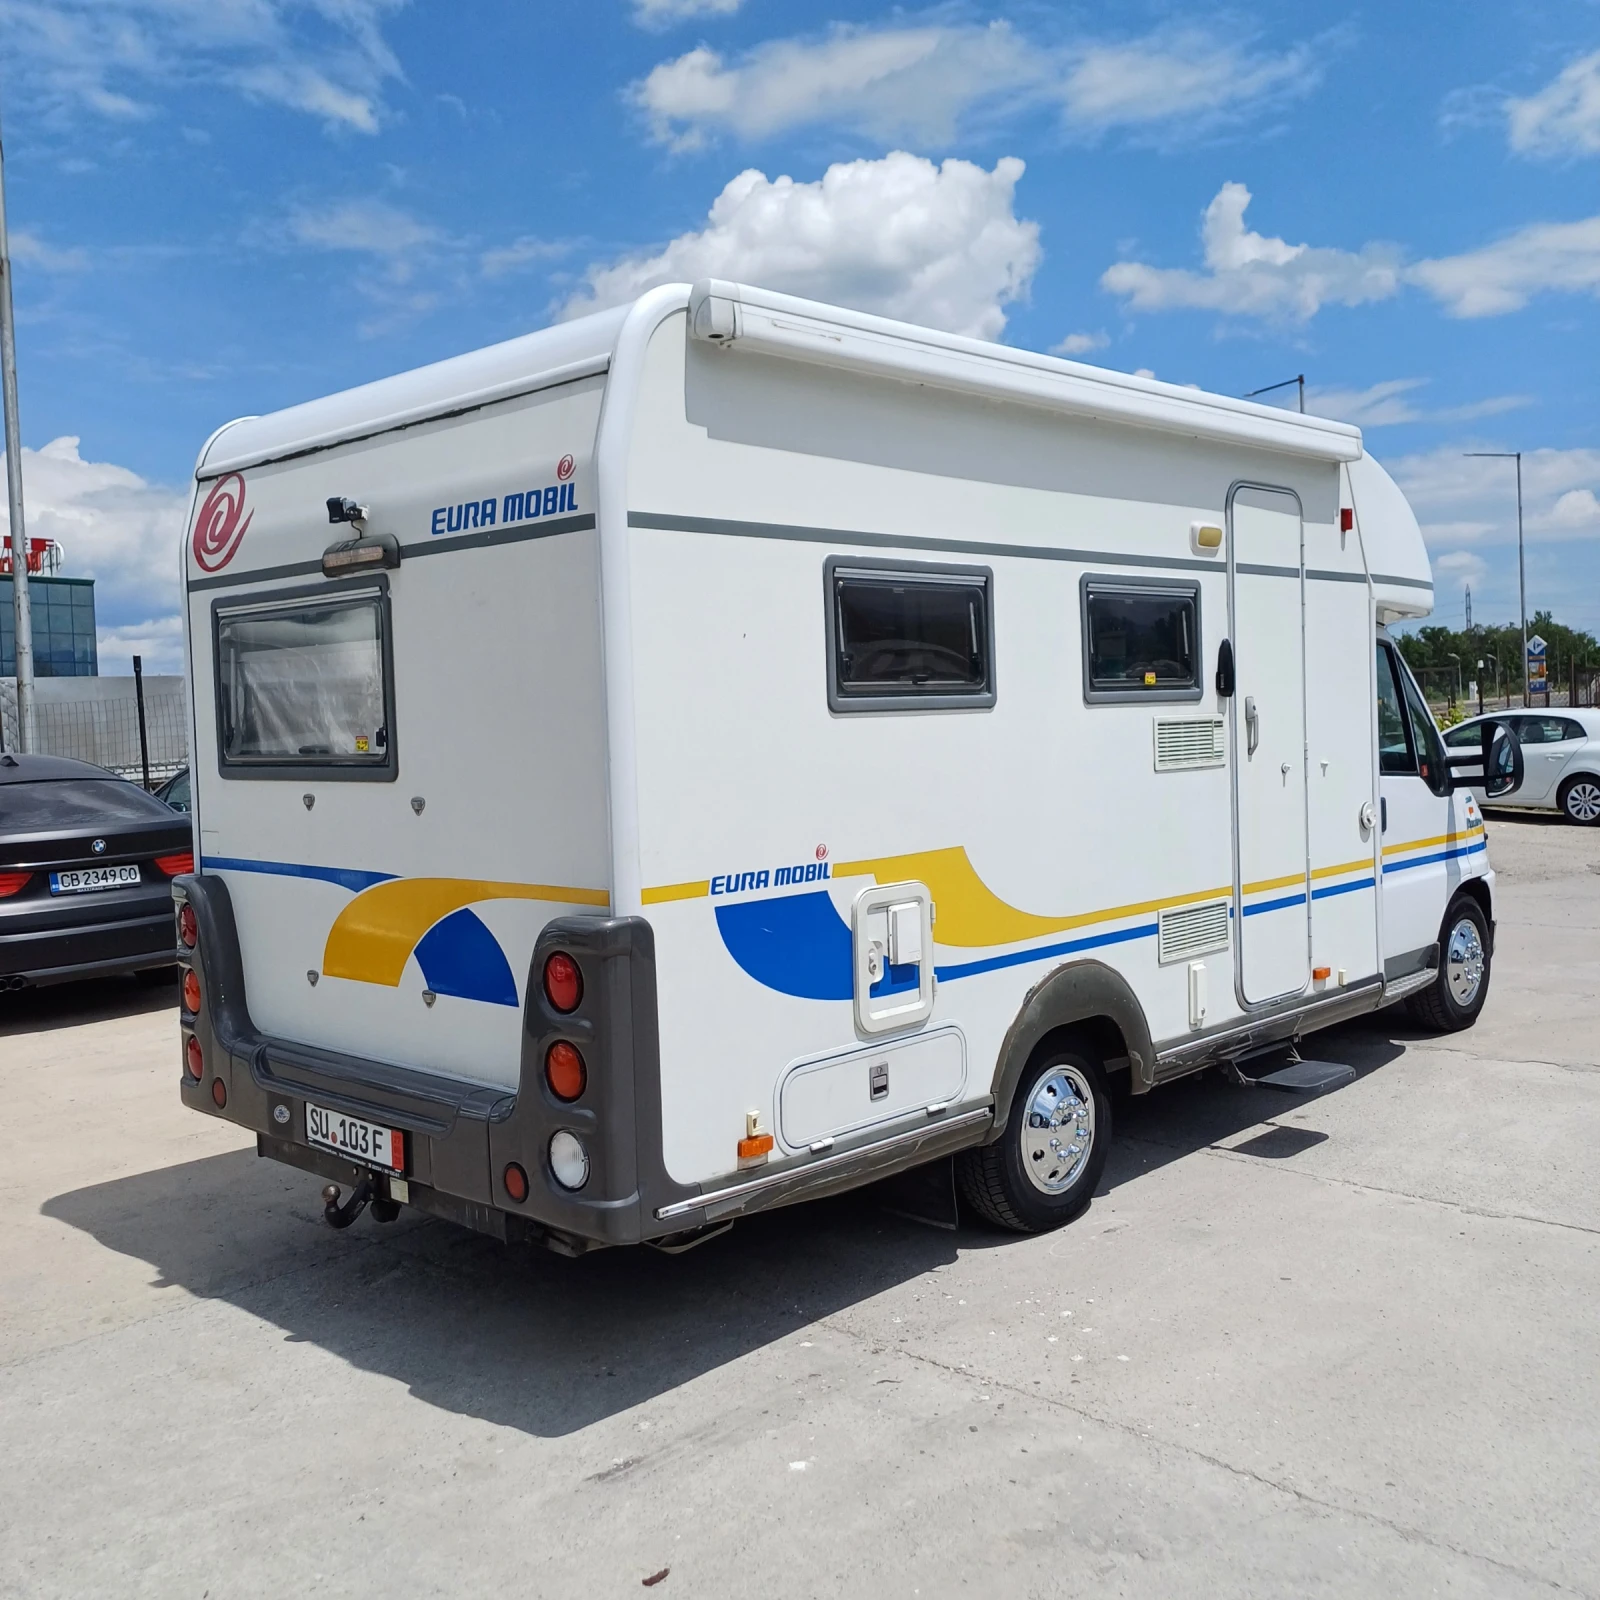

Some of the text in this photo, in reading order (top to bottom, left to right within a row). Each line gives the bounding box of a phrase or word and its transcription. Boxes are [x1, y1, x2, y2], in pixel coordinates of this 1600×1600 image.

[431, 483, 578, 535] EURA MOBIL
[60, 867, 138, 888] CB 2349 CO
[711, 862, 830, 895] EURA MOBIL
[310, 1107, 330, 1140] SU
[339, 1118, 369, 1154] 103
[372, 1129, 384, 1158] F
